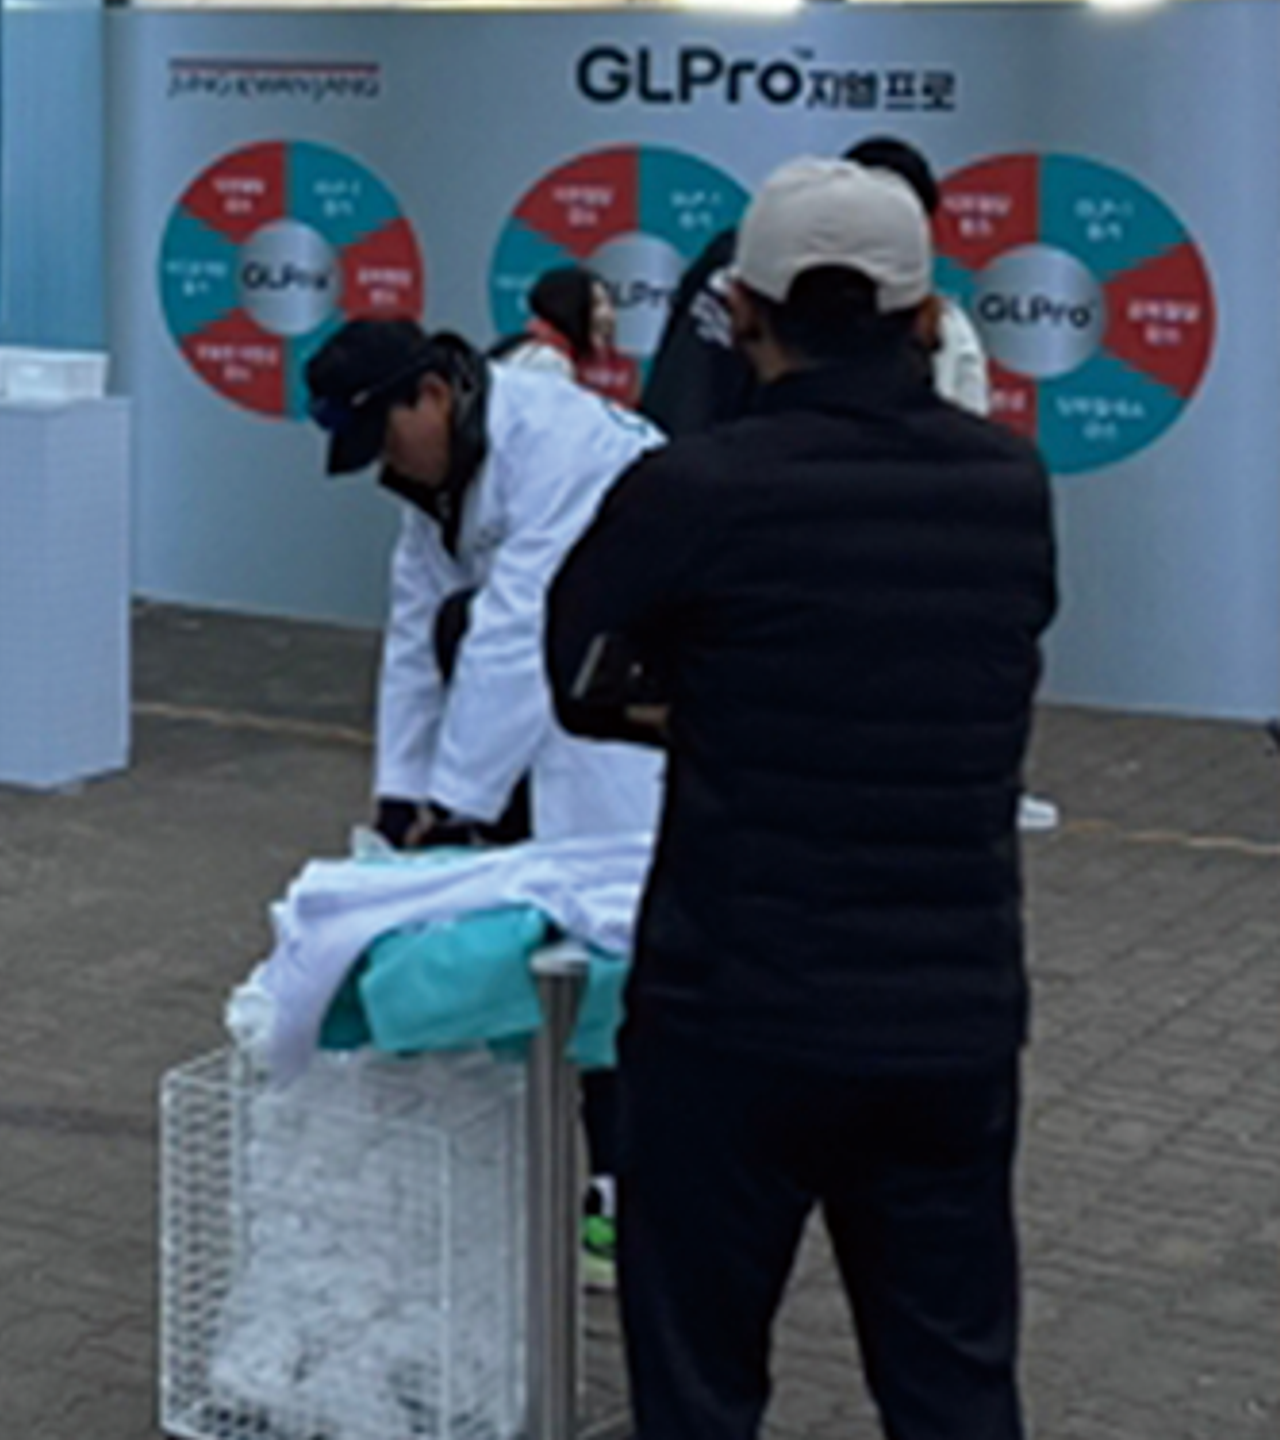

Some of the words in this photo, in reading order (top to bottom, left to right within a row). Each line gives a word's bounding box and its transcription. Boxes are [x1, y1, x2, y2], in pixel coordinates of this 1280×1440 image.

[575, 44, 804, 106] GLPro
[805, 69, 956, 112] 지엘프로
[977, 293, 1092, 329] GLPro
